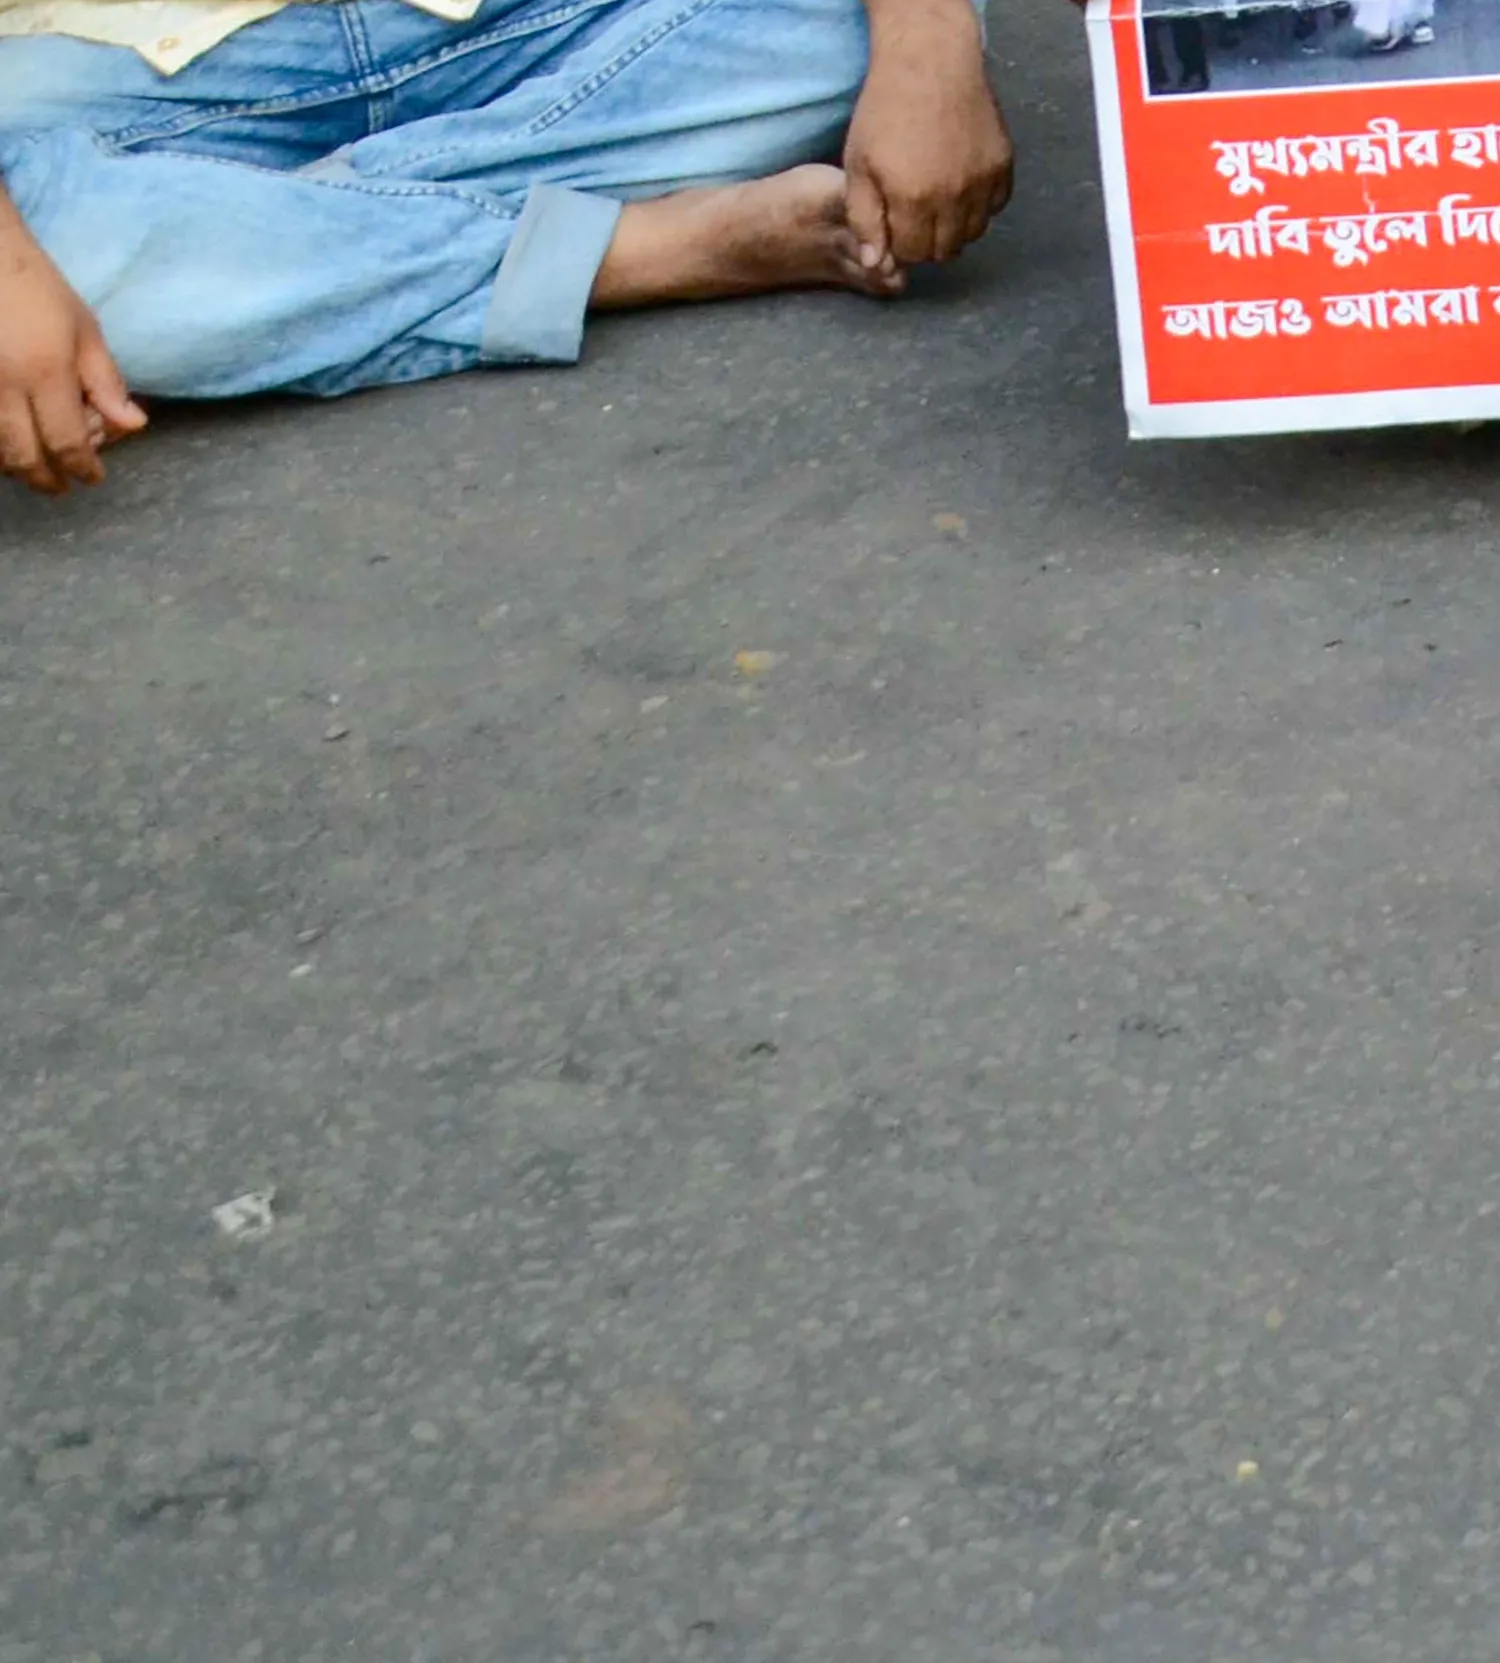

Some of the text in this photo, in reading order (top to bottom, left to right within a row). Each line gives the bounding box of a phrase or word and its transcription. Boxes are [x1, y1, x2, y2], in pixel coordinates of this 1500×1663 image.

[1211, 117, 1439, 195] মুখ্যমন্ত্রীর
[1205, 205, 1310, 259] দাবি
[1322, 211, 1428, 267] তুলে
[1162, 298, 1312, 339] আজও
[1322, 286, 1479, 328] আমরা
